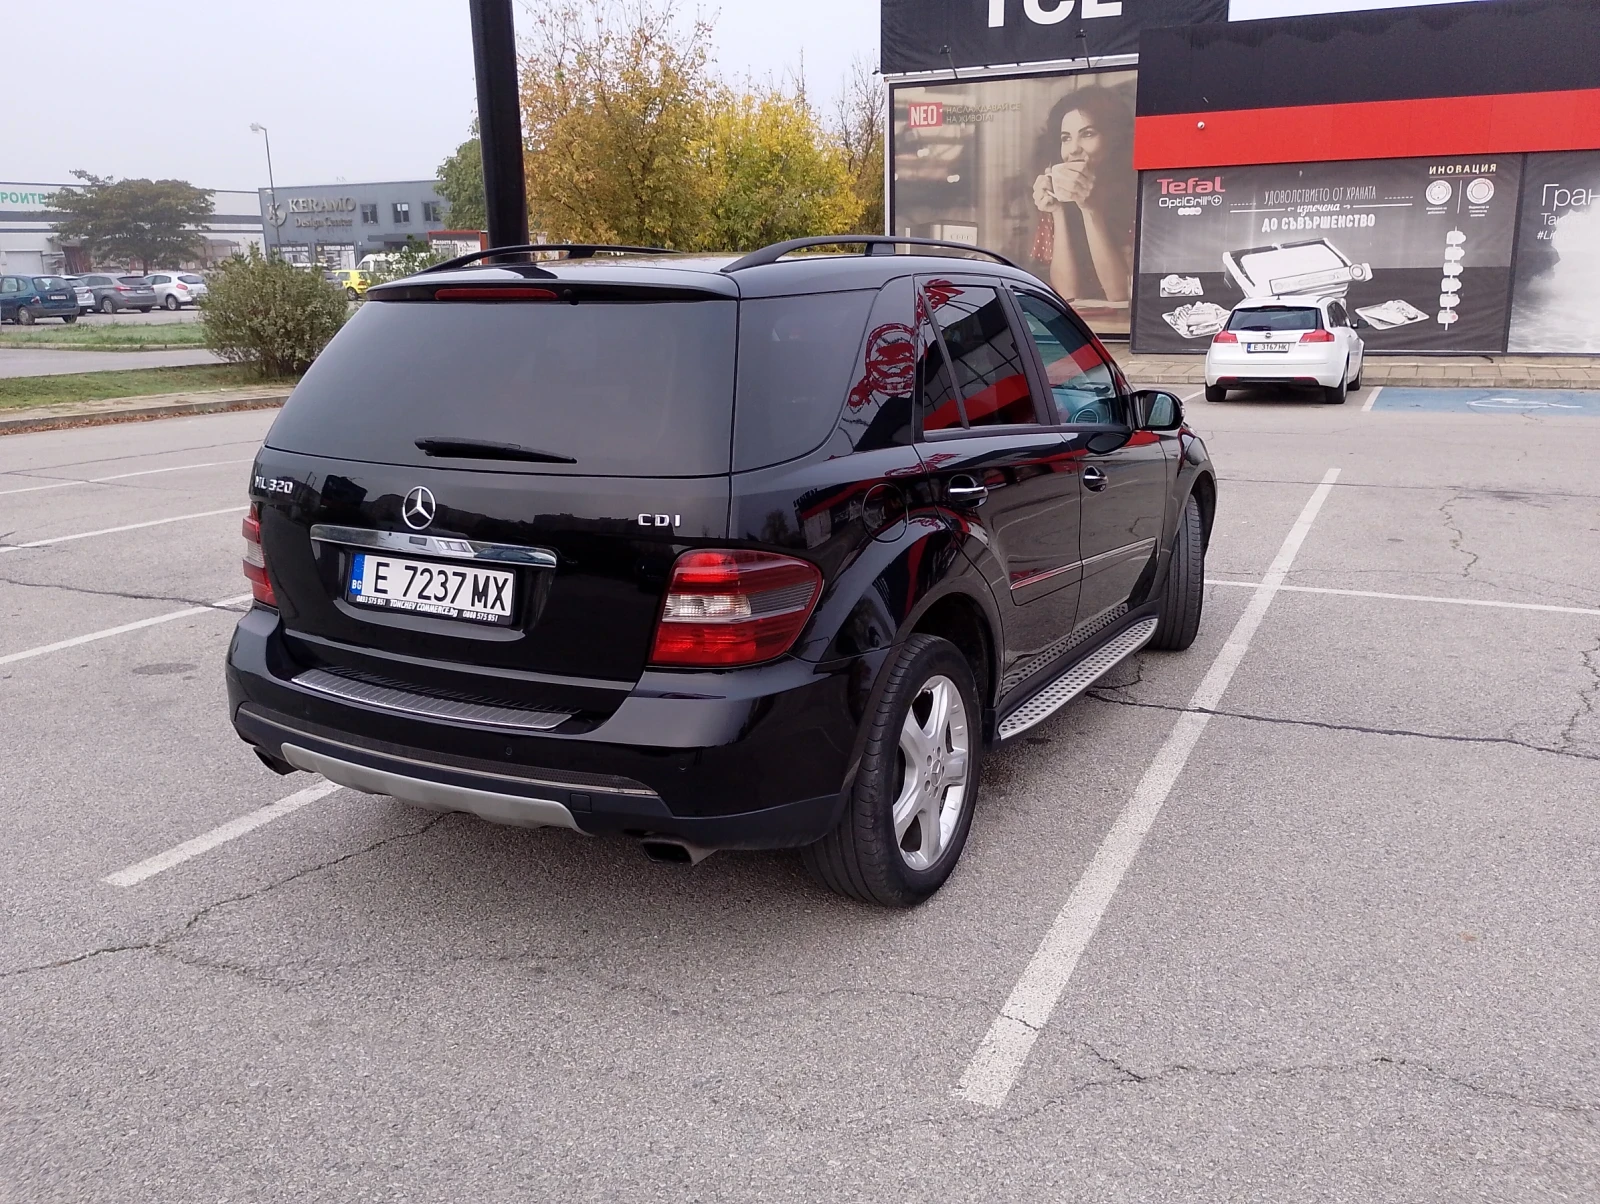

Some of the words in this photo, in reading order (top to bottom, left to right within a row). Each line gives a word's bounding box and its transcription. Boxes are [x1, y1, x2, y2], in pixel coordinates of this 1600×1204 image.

[910, 105, 937, 126] NEO
[946, 103, 1008, 115] НАСЛАЖДАВАЙ
[1010, 103, 1021, 112] СЕ
[946, 116, 957, 124] НА
[1429, 163, 1497, 175] ИНОВАЦИЯ
[1156, 176, 1226, 195] Tefal
[1264, 188, 1330, 206] УДОВОЛСТВИЕТО
[1332, 187, 1344, 202] ОТ
[1345, 185, 1377, 201] ХРАНАТА
[288, 197, 357, 213] KERAMO
[1297, 203, 1341, 217] изпечена
[1261, 217, 1279, 233] ДО
[1281, 213, 1376, 231] СЪВЪРШЕНСТВО
[268, 478, 294, 494] 320
[638, 513, 681, 527] CDI
[351, 579, 363, 590] BG
[373, 561, 391, 595] E
[402, 564, 468, 605] 7237
[470, 573, 510, 612] MX
